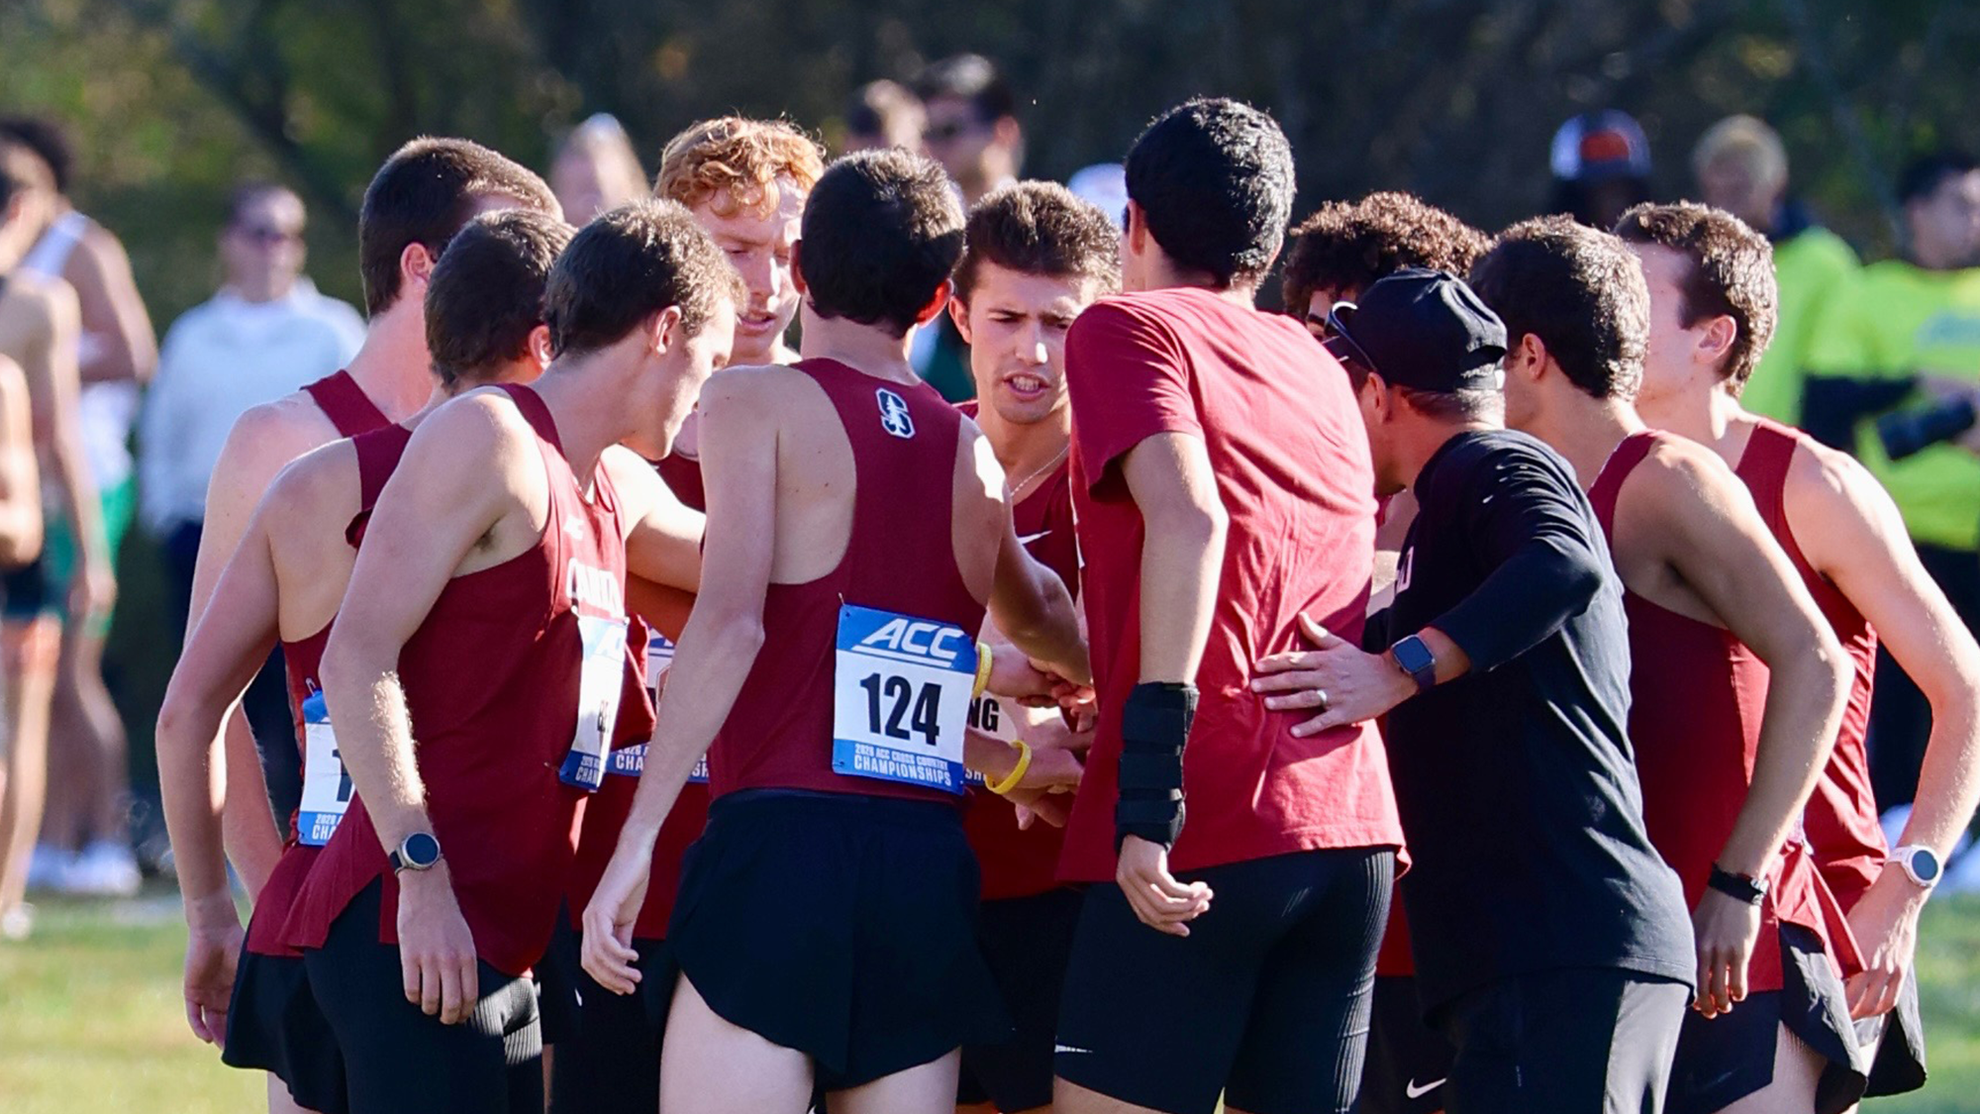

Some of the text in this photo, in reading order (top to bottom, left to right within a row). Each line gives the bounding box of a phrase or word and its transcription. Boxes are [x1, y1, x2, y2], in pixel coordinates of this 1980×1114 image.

[862, 618, 964, 659] ACC
[860, 672, 943, 746] 124
[854, 754, 952, 786] CHAMPIONSHIPS
